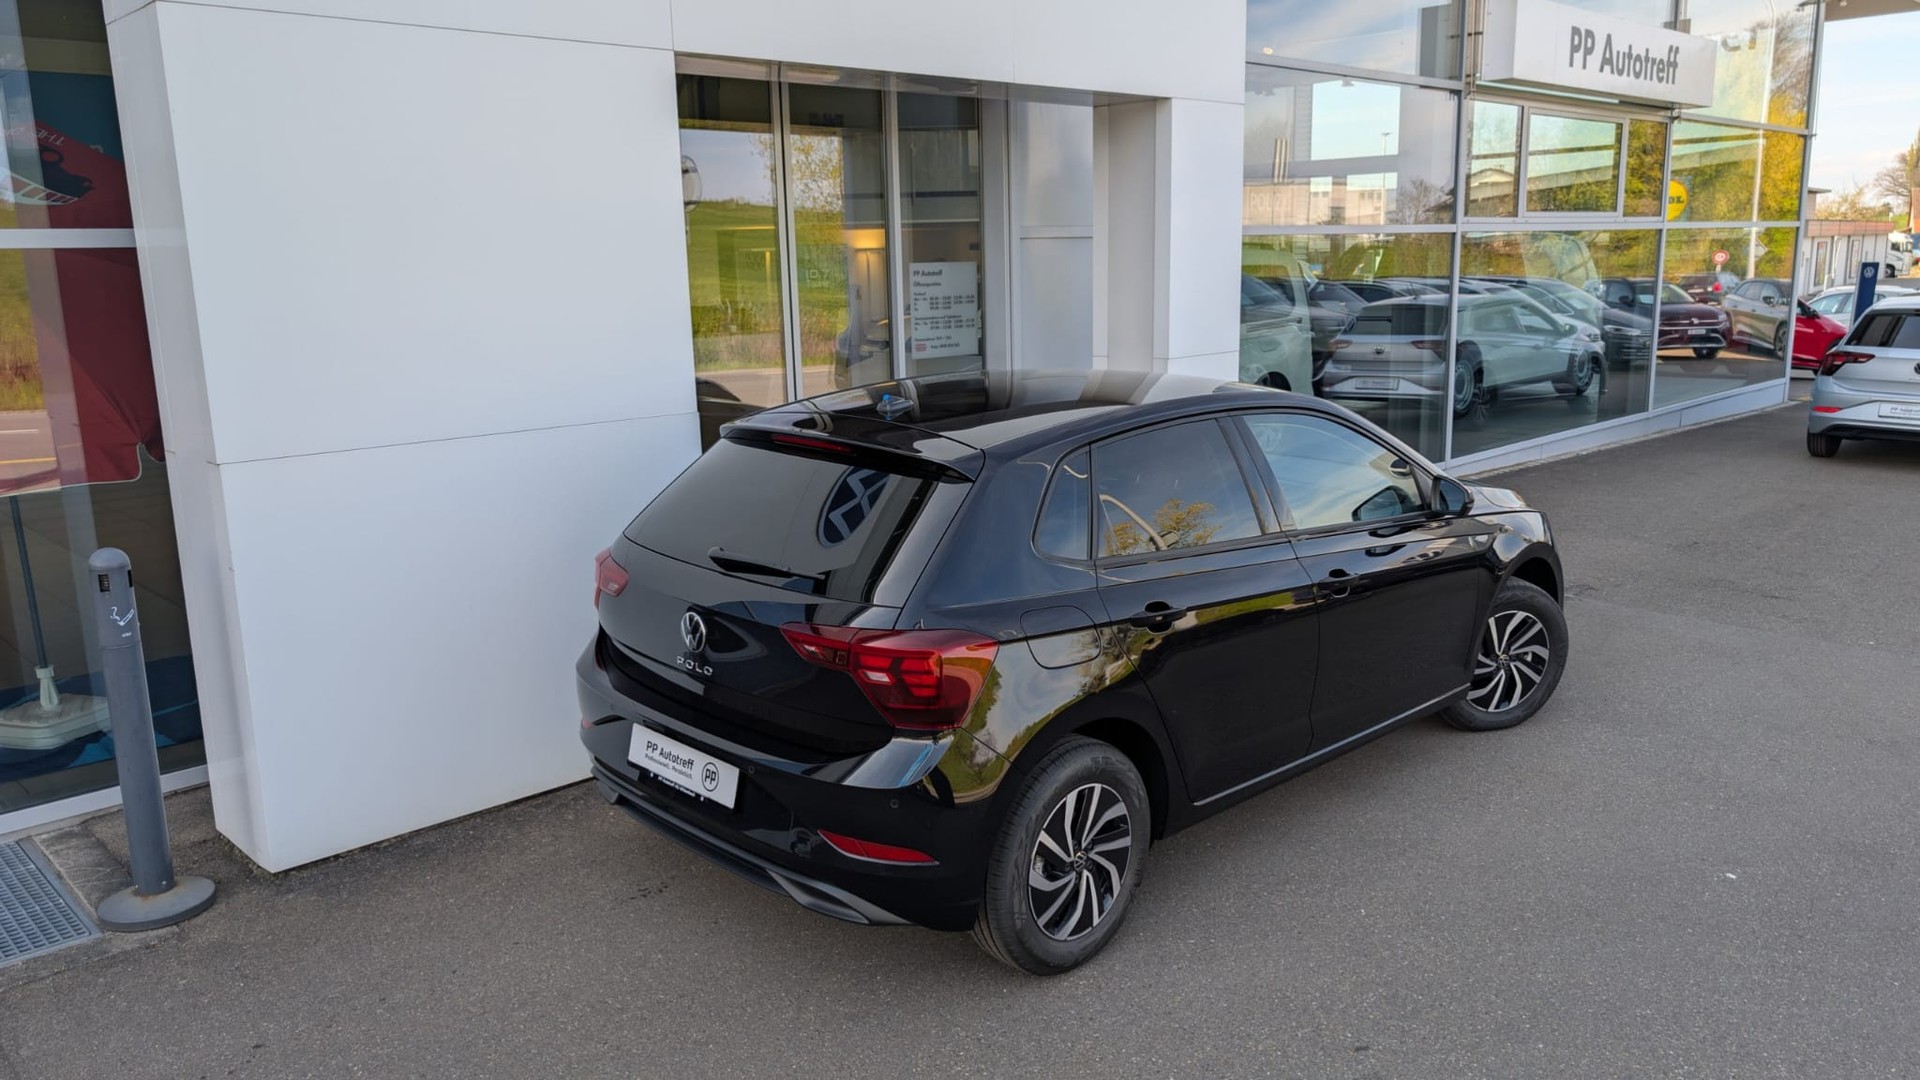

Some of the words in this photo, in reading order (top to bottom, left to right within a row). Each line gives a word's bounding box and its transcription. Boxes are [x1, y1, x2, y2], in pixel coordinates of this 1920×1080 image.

[1569, 25, 1595, 70] PP
[1599, 33, 1680, 85] Autotreff
[676, 655, 714, 676] POLO
[646, 740, 658, 753] PP
[659, 747, 695, 771] Autotreff
